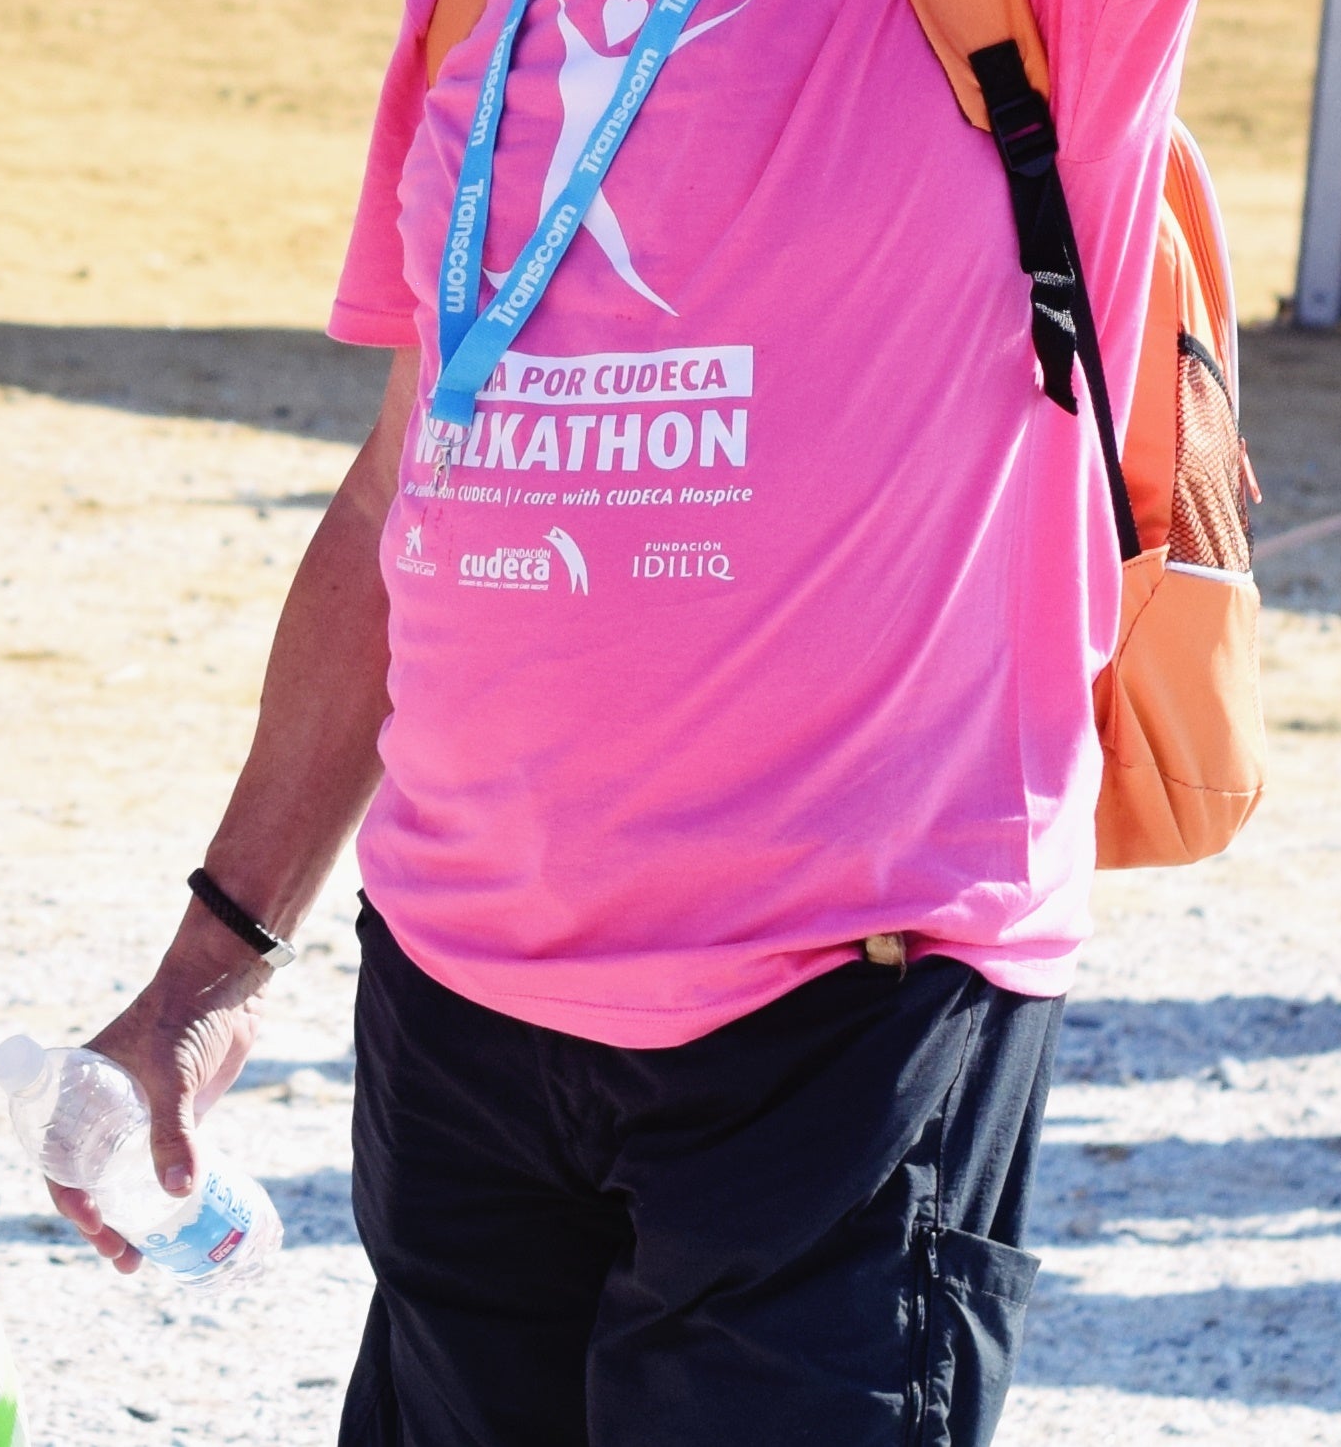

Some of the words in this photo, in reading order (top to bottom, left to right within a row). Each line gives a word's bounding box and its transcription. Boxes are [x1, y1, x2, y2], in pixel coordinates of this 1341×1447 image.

[471, 17, 517, 146] Transcom
[578, 47, 659, 175] Transcom
[445, 178, 484, 313] Transcom
[486, 203, 578, 327] Transcom
[519, 365, 587, 397] POR
[593, 358, 728, 395] CUDECA
[458, 484, 501, 504] CUDECA
[523, 491, 557, 506] care
[562, 486, 601, 506] with
[606, 487, 673, 506] CUDECA
[679, 484, 753, 507] Hospice
[460, 548, 550, 582] cudeca
[644, 539, 722, 552] FUNDACIÓN
[632, 555, 735, 581] IDILIQ
